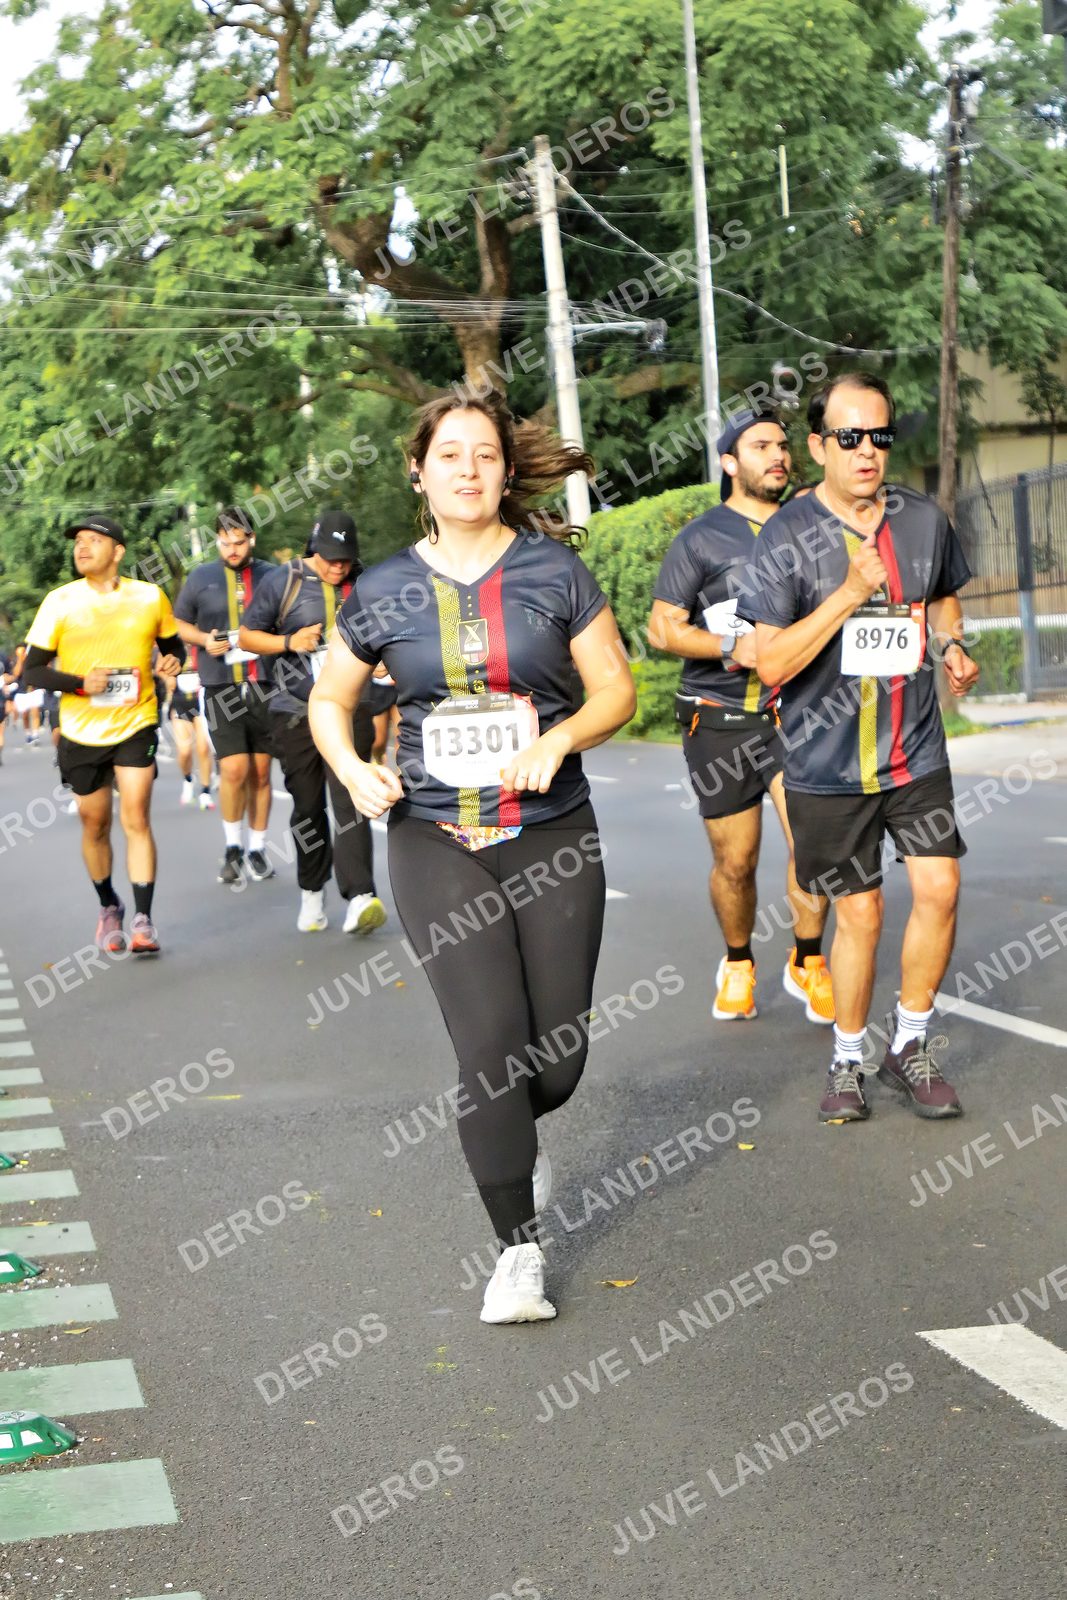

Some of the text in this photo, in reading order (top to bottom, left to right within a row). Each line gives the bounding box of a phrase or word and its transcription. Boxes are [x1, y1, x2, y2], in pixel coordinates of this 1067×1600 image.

[855, 627, 909, 650] 8976
[106, 679, 131, 693] 999
[428, 722, 520, 757] 13301
